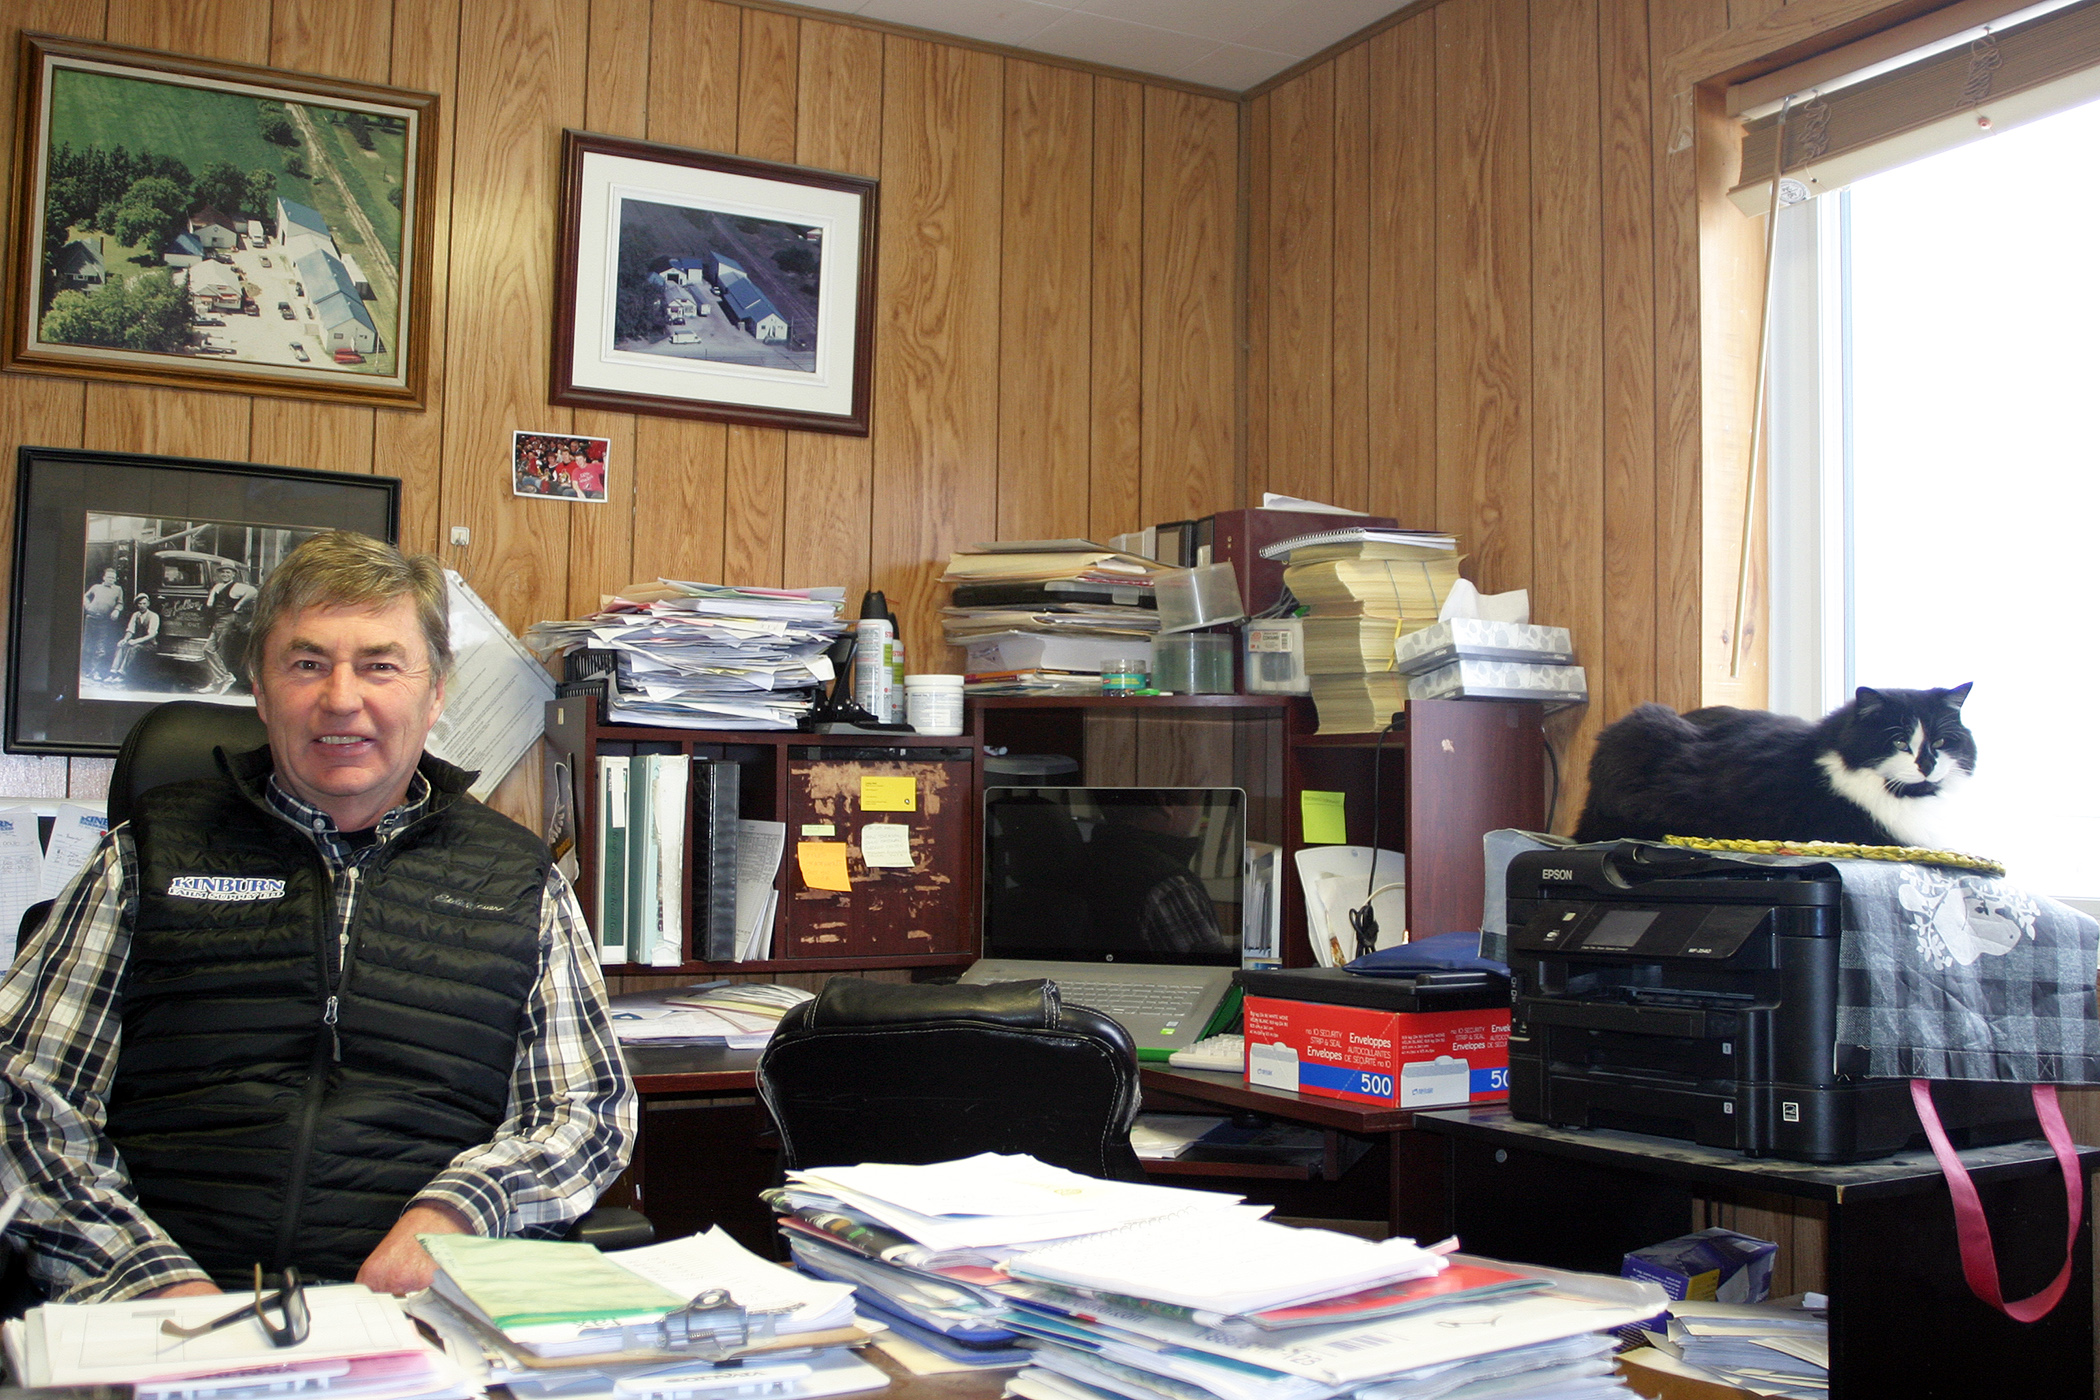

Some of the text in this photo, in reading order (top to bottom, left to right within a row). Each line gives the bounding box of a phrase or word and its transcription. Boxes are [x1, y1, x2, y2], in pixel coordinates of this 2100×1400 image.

[1542, 869, 1573, 880] EPSON
[171, 876, 286, 893] KINBURN
[1320, 1029, 1343, 1039] SECURITY
[1310, 1036, 1324, 1045] STRIP
[1329, 1039, 1343, 1048] SEAL
[1349, 1032, 1392, 1049] Enveloppes
[1452, 1041, 1486, 1051] Envelopes
[1307, 1046, 1343, 1061] Envelopes
[1344, 1054, 1352, 1063] DE
[1347, 1046, 1392, 1059] AUTOCOLLANTES
[1361, 1073, 1392, 1096] 500
